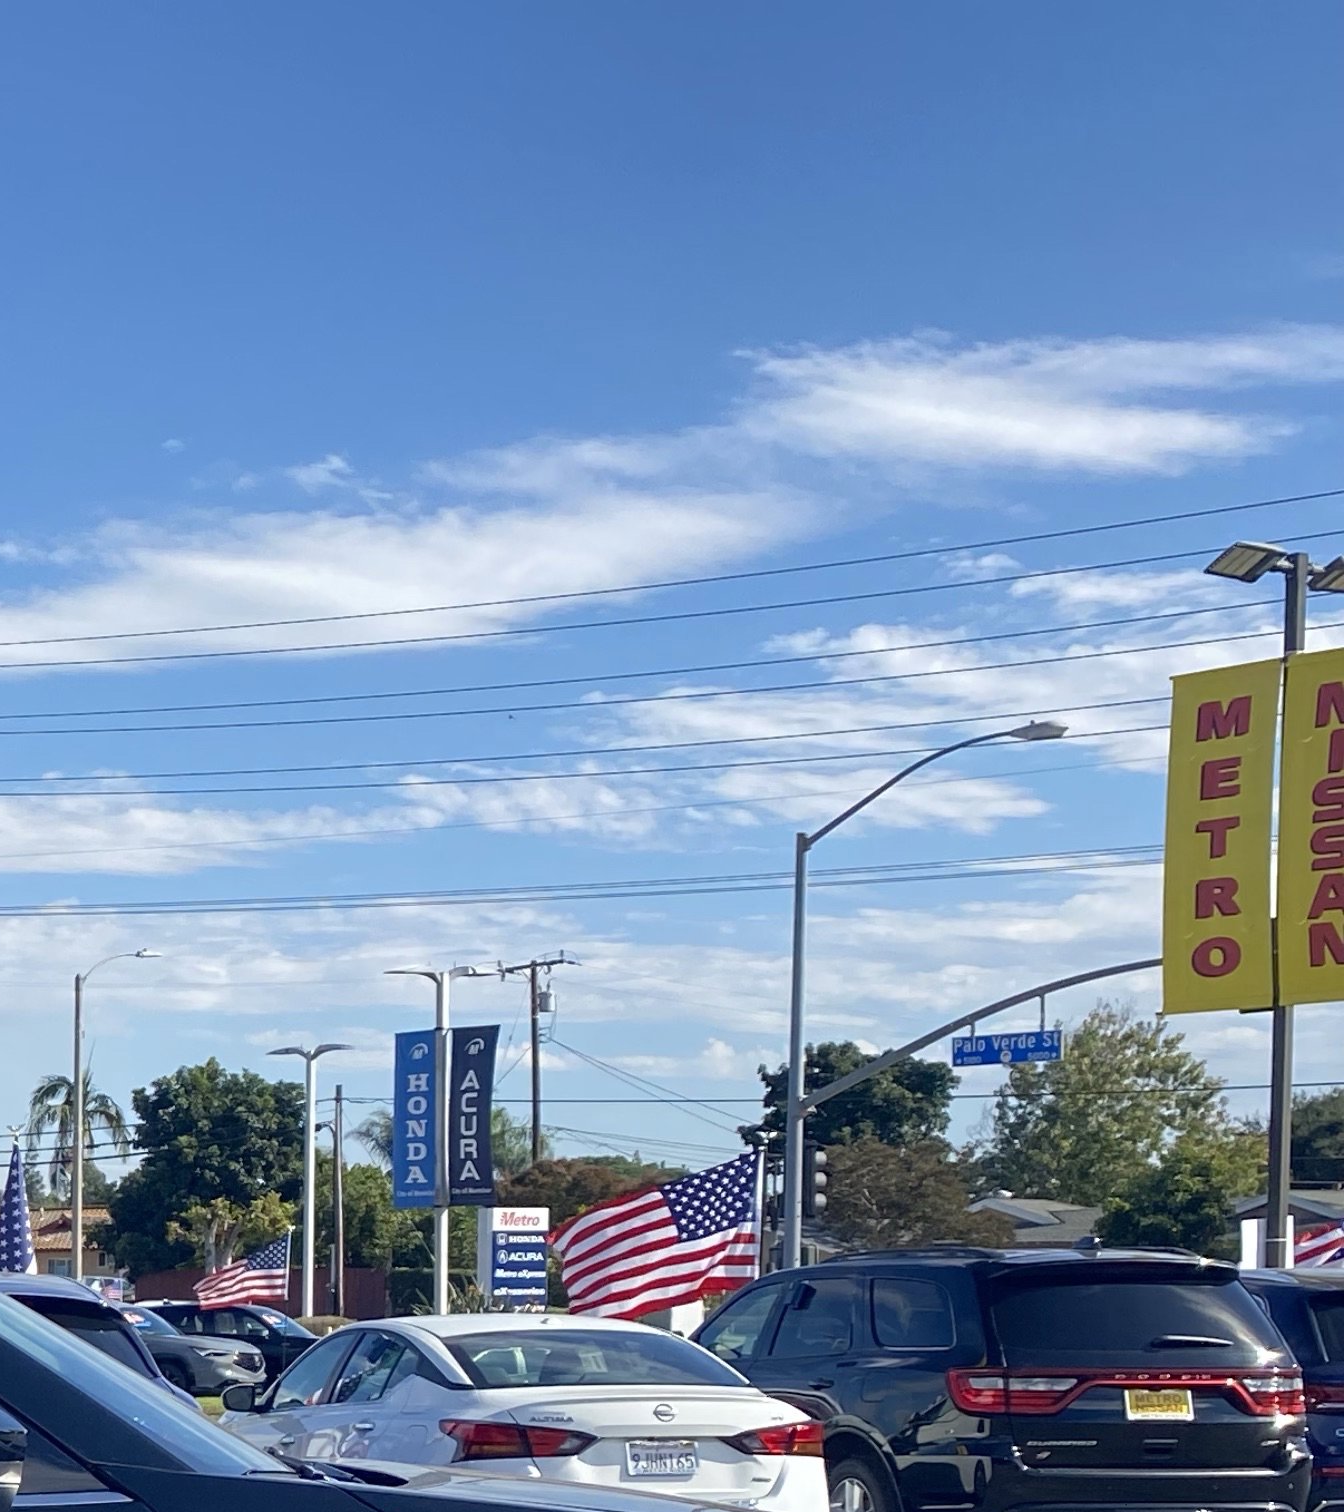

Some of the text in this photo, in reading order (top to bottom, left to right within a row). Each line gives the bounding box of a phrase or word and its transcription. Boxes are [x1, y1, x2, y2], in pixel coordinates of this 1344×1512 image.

[1191, 695, 1252, 978] METRO
[953, 1032, 1059, 1054] Palo Verde St
[405, 1073, 429, 1184] HONDA
[459, 1070, 480, 1181] ACURA
[500, 1212, 540, 1227] Metro
[509, 1235, 545, 1244] HONDA
[509, 1251, 544, 1261] ACURA
[1135, 1394, 1182, 1403] METRO
